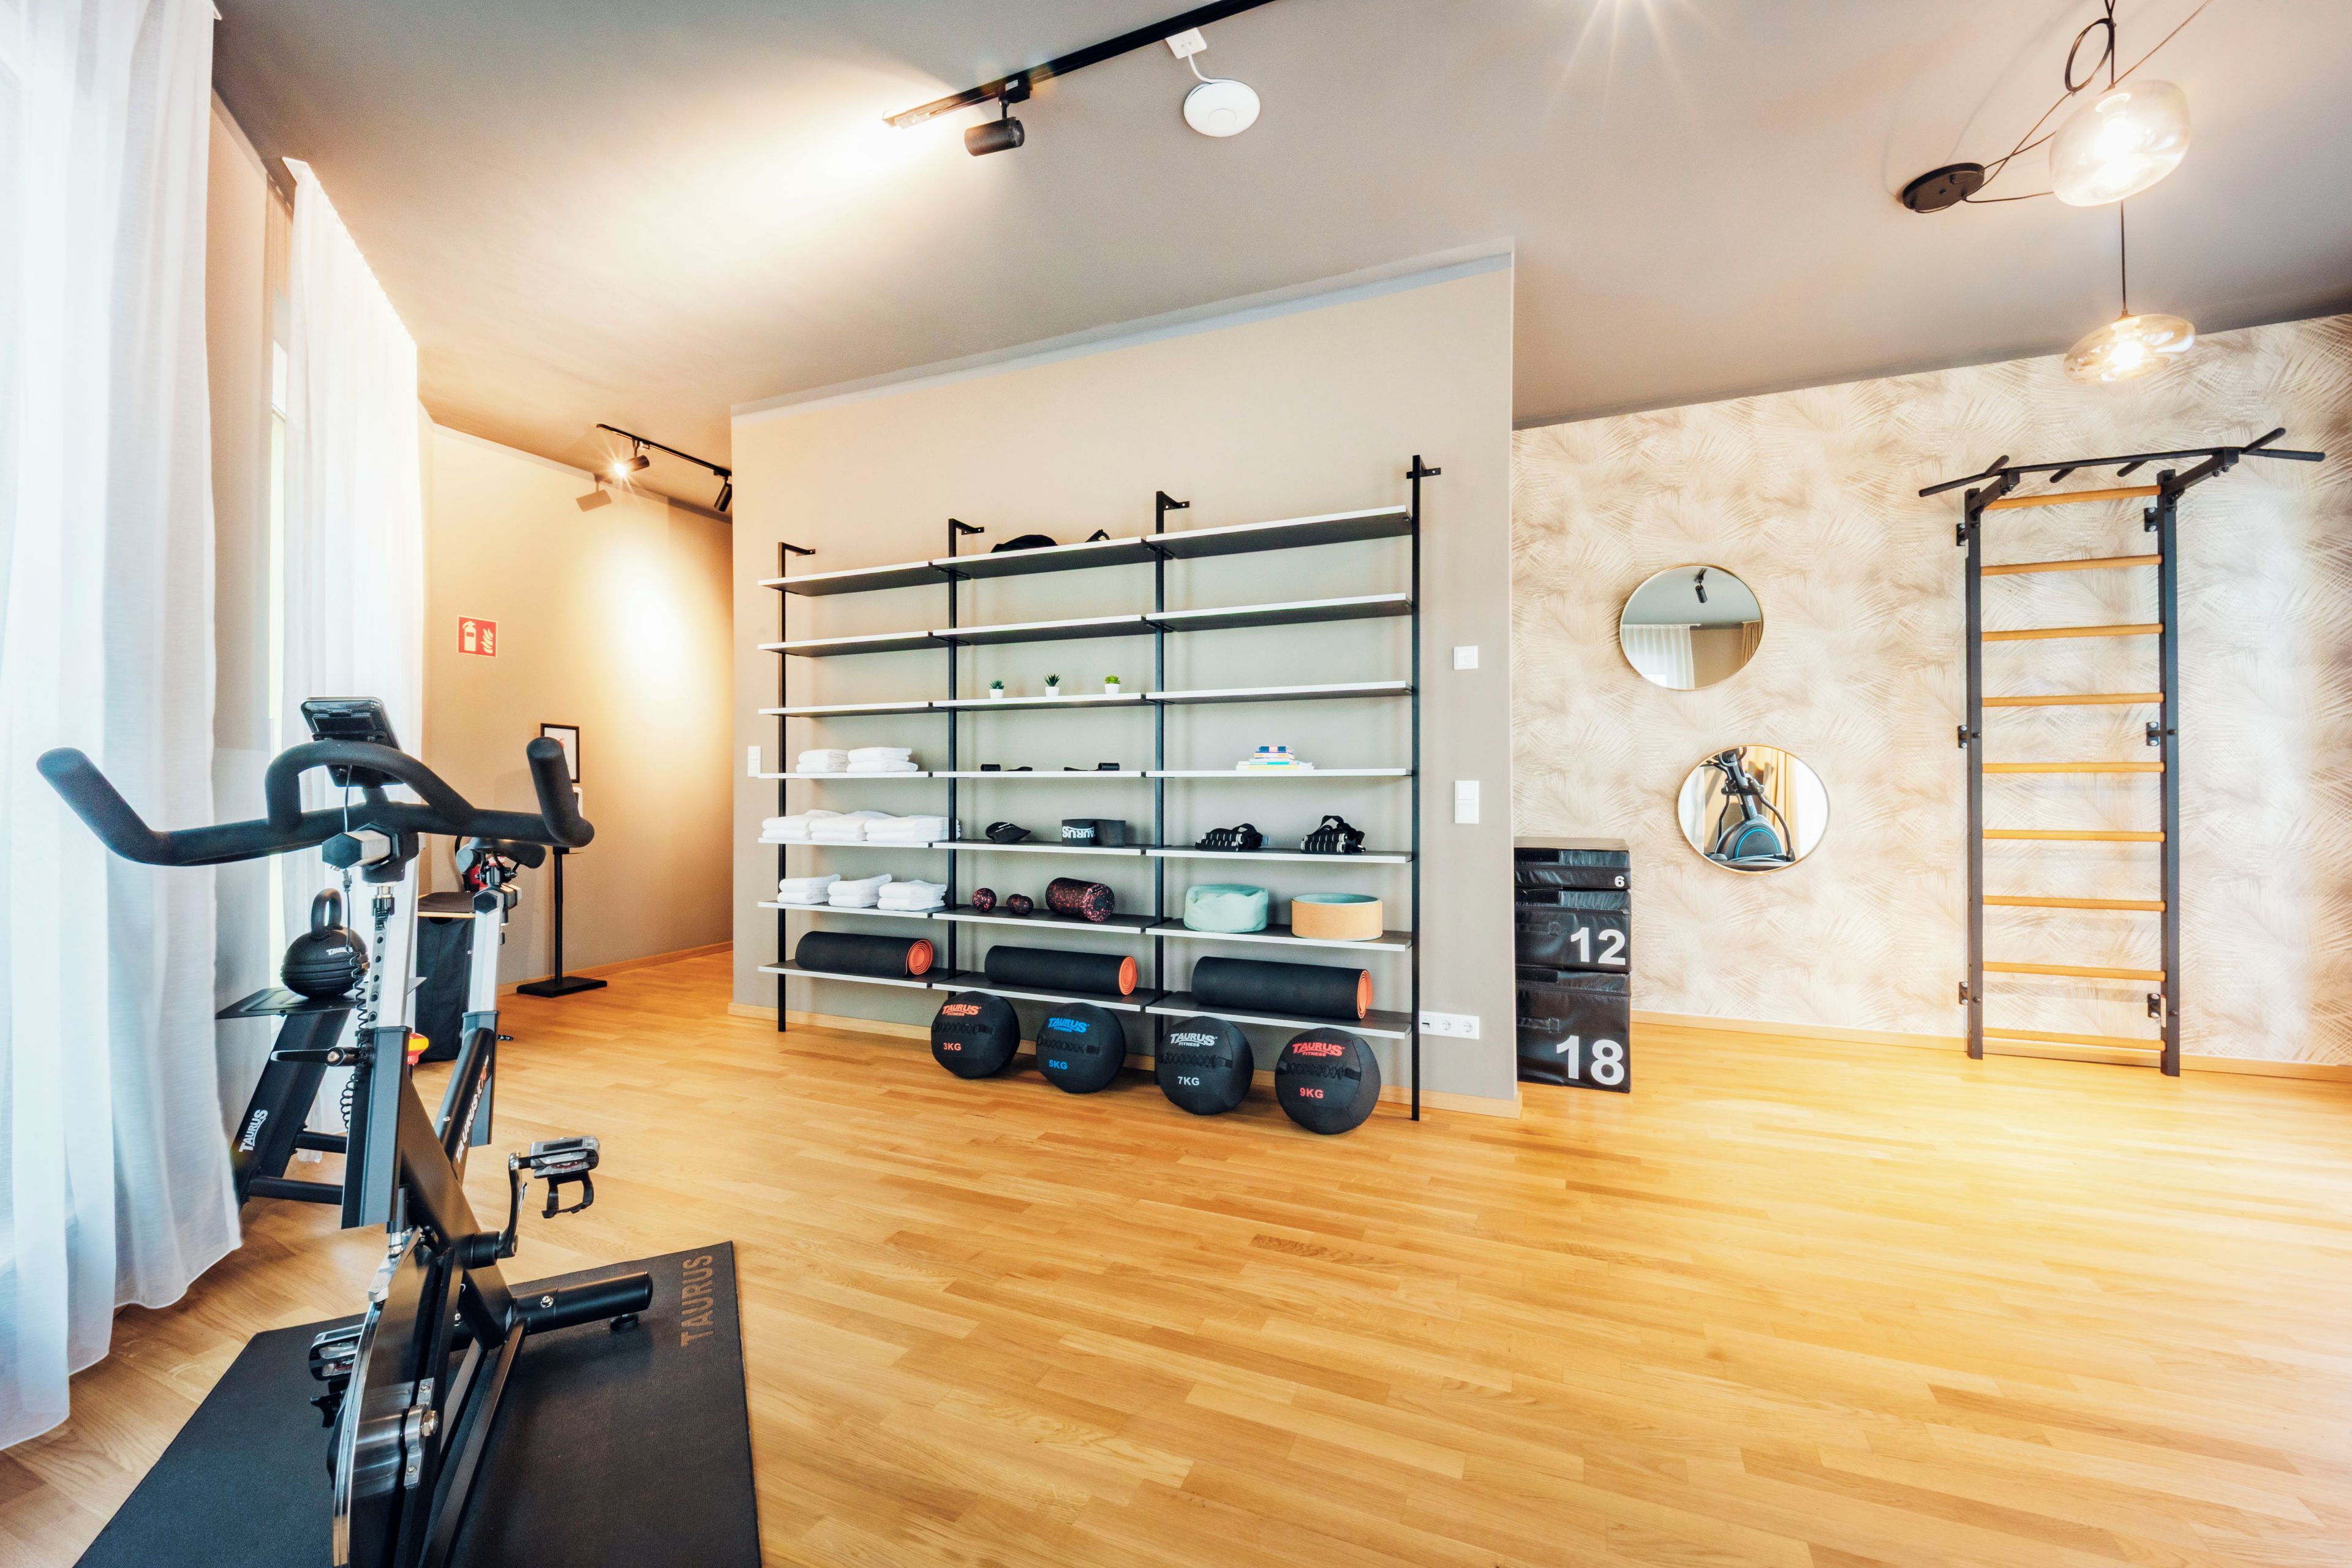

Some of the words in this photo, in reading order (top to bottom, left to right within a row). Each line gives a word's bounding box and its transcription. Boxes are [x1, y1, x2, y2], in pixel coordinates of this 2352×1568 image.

[1062, 826, 1095, 839] AURUS
[1614, 875, 1625, 888] 6
[1570, 927, 1627, 966] 12
[942, 1004, 979, 1016] TAURUS
[1048, 1017, 1088, 1033] TAURUS
[1170, 1033, 1216, 1046] TAURUS
[943, 1042, 962, 1052] 3KG
[1292, 1042, 1343, 1057] TAURUS
[1049, 1059, 1068, 1070] 5KG
[1556, 1035, 1625, 1086] 18
[1177, 1076, 1200, 1087] 7KG
[1300, 1087, 1324, 1099] 9KG
[238, 1109, 269, 1153] TAURUS
[456, 1093, 478, 1164] TAURUS
[680, 1255, 714, 1348] TAURUS
